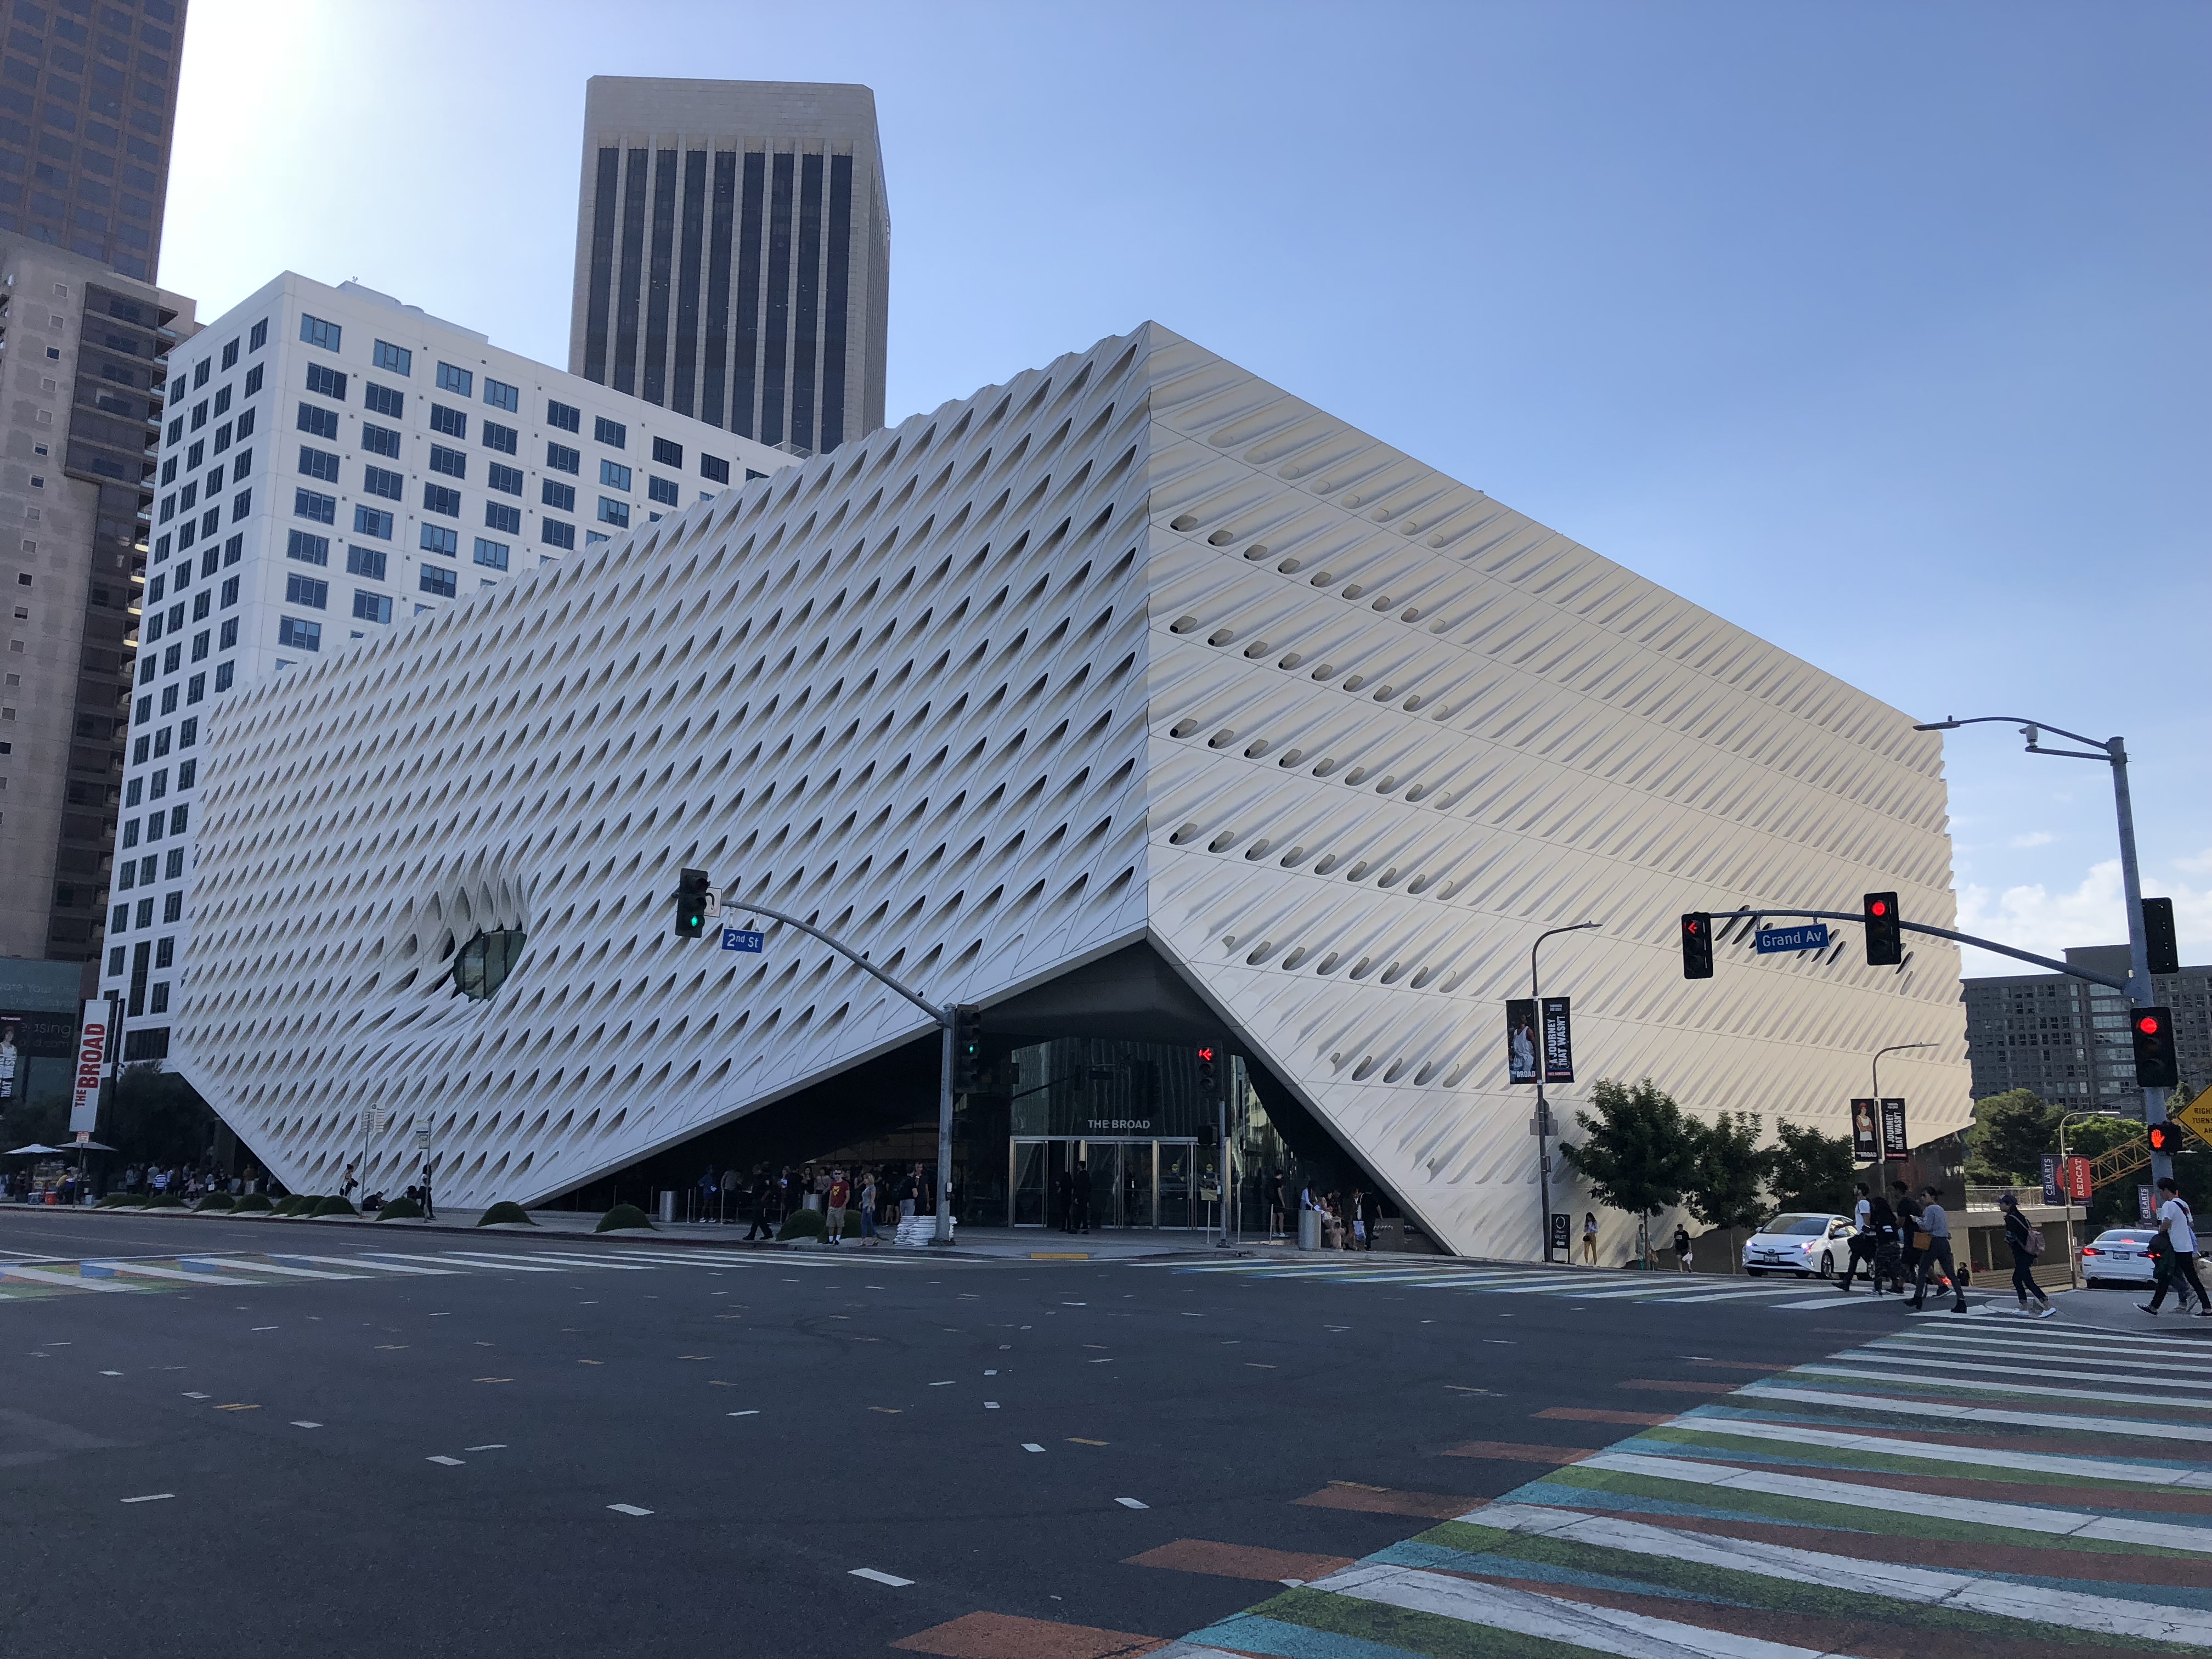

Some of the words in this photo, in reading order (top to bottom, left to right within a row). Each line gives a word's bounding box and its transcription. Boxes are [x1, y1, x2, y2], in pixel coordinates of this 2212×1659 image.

[727, 933, 746, 947] 2nd
[748, 936, 759, 948] St
[1762, 932, 1801, 947] Grand
[1806, 930, 1821, 943] Av
[1547, 1019, 1558, 1058] JOURNEY
[1556, 1015, 1567, 1046] WASN'T
[77, 1023, 106, 1089] BROAD
[1558, 1049, 1568, 1066] THAT
[1, 1080, 13, 1098] THAT
[75, 1090, 87, 1108] THE
[1087, 1120, 1109, 1128] THE
[1111, 1120, 1150, 1128] BROAD
[1886, 1114, 1894, 1143] JOURNEY
[1895, 1136, 1904, 1150] THAT
[2075, 1159, 2084, 1197] REDCAT
